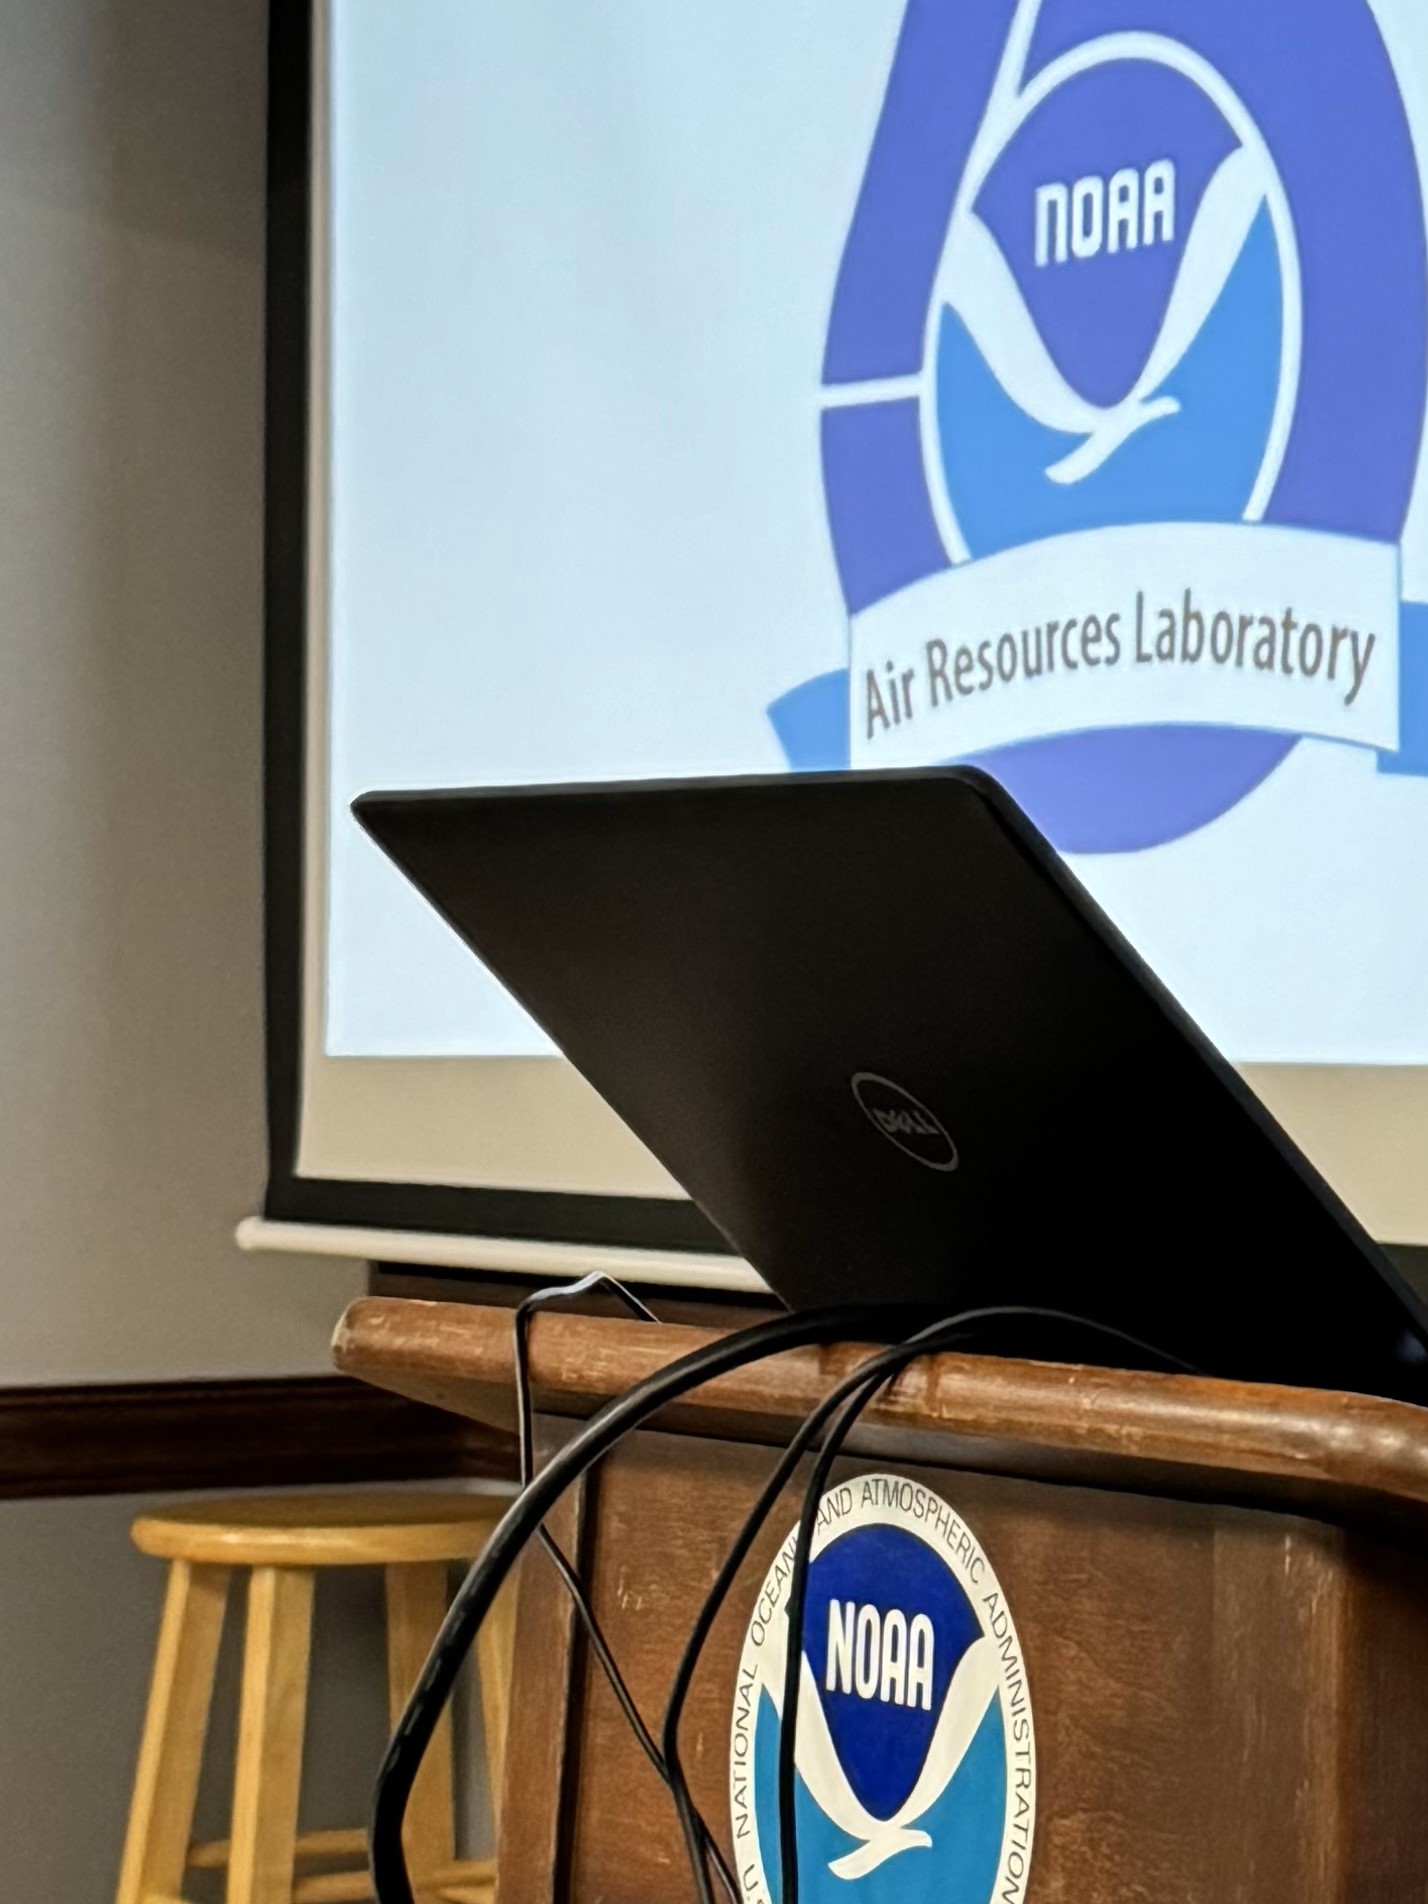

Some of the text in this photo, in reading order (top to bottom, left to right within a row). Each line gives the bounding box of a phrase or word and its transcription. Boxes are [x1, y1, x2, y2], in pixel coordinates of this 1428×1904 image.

[1033, 157, 1177, 269] NOAA
[864, 587, 1377, 742] Air Resources Laboratory
[732, 1663, 759, 1839] NATIONAL
[750, 1534, 799, 1648] OCEAN
[816, 1486, 853, 1536] AND
[861, 1478, 986, 1585] ATMOSPHERIC
[825, 1598, 935, 1711] NOAA
